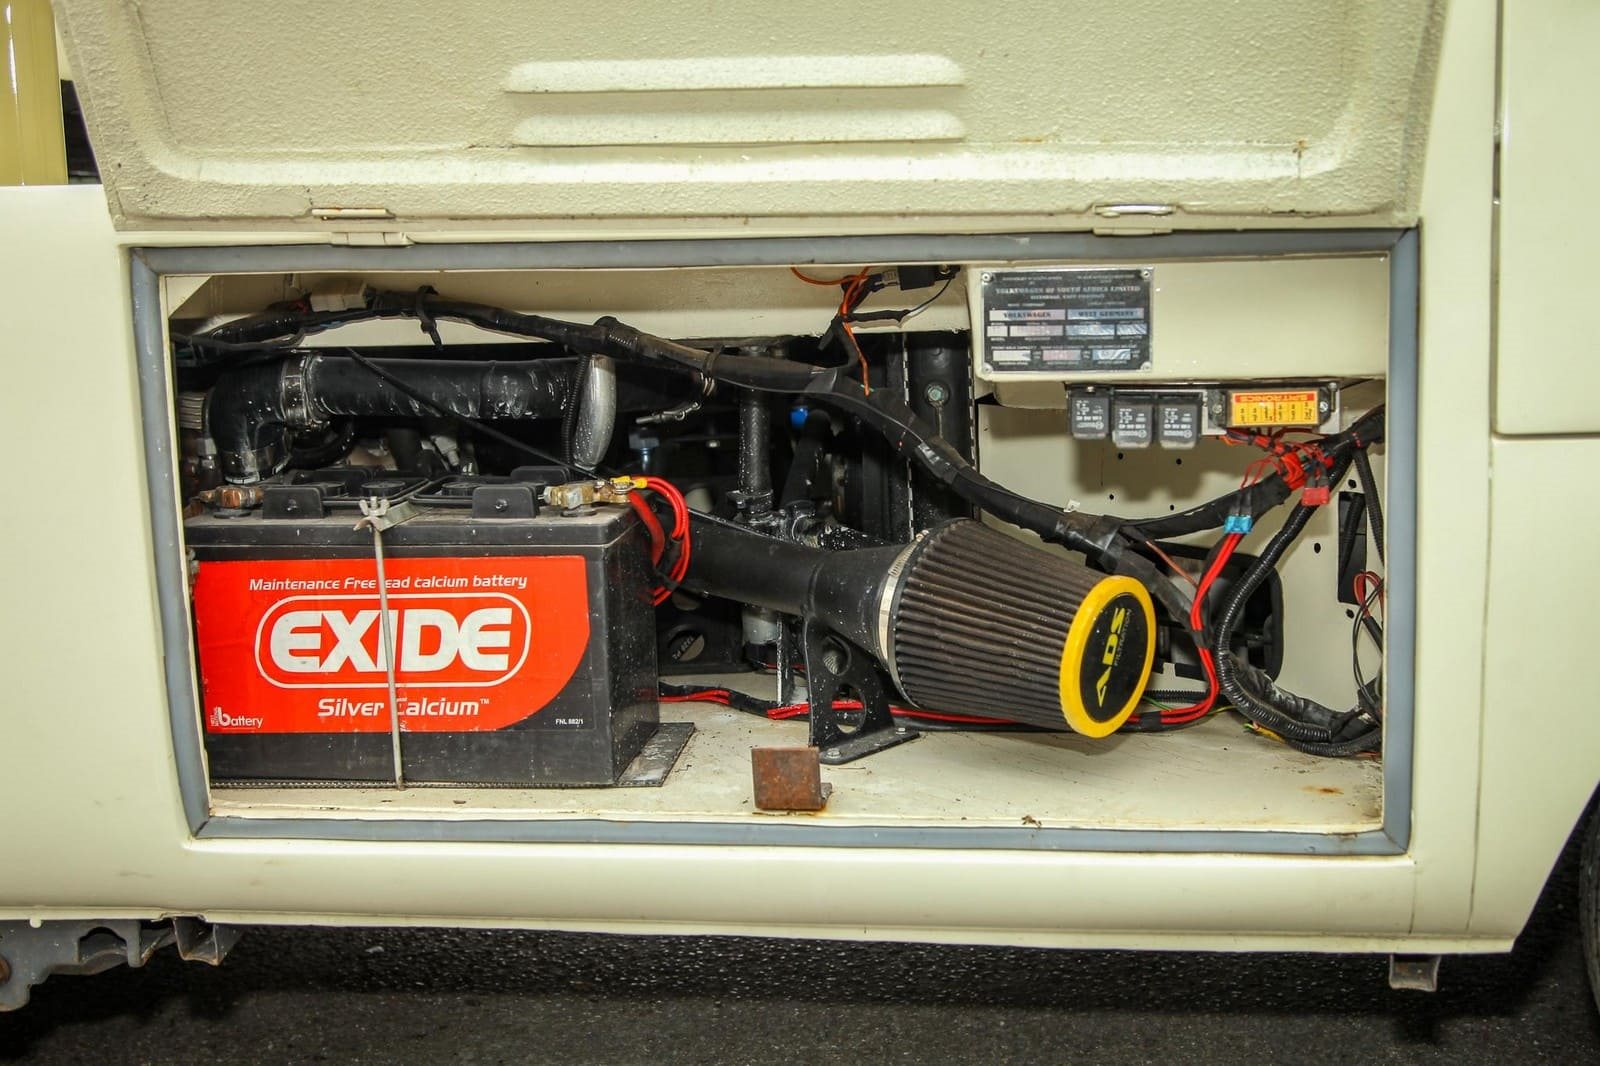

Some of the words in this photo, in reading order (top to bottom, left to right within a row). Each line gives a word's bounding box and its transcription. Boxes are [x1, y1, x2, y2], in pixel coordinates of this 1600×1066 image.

[249, 578, 340, 591] Maintenance
[344, 577, 376, 590] Free
[385, 576, 410, 589] ead
[414, 576, 468, 589] calcium
[472, 575, 528, 590] battery
[270, 607, 513, 673] EXIDE
[1096, 607, 1126, 708] ADS
[318, 697, 385, 717] Silver
